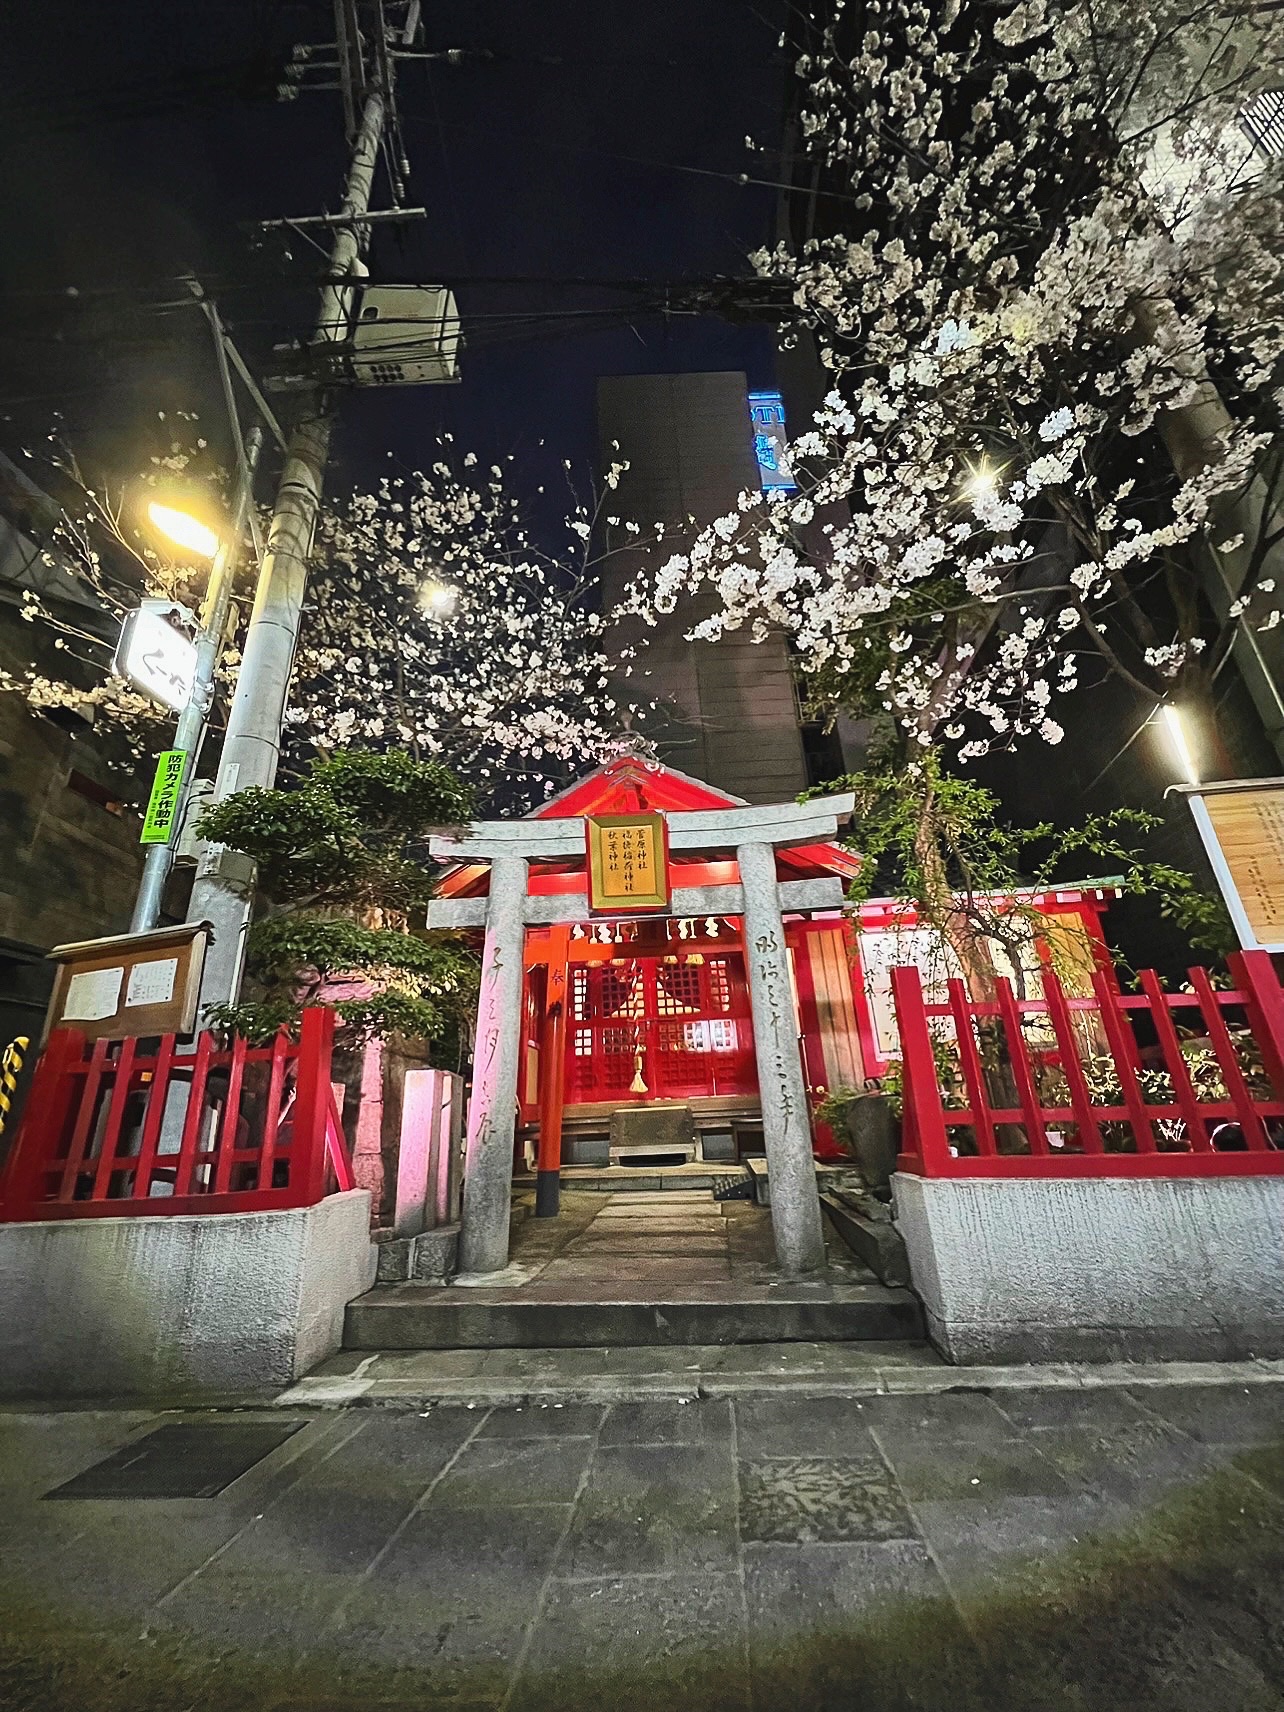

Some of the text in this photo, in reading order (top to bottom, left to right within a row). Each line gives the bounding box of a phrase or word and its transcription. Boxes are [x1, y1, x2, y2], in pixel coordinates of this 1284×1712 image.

[154, 754, 184, 828] 防犯カメラ作動中
[551, 968, 564, 986] 奉
